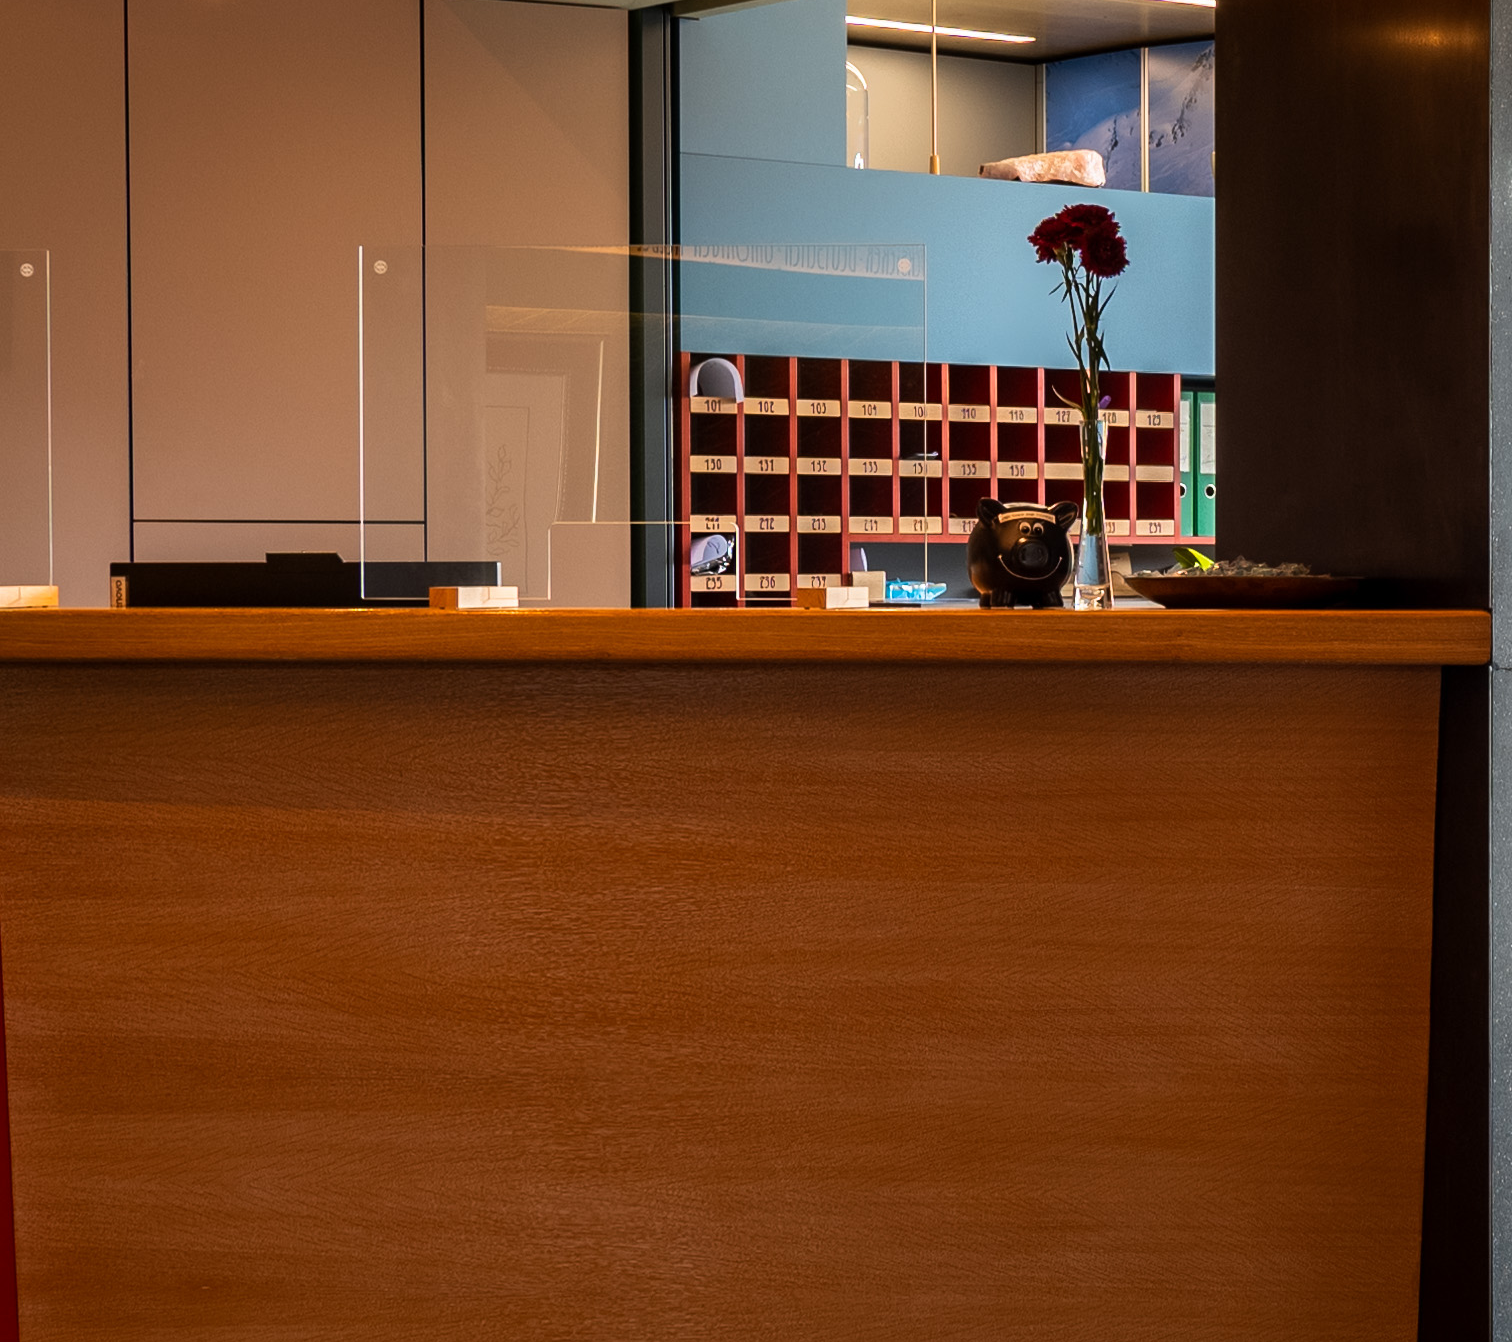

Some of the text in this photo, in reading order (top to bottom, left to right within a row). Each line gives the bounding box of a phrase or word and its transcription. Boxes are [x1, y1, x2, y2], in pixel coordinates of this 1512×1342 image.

[704, 399, 722, 412] 101
[757, 400, 775, 414] 102
[810, 402, 827, 415] 103
[960, 407, 976, 419] 110
[704, 458, 722, 471] 130
[758, 459, 774, 472] 131
[759, 517, 775, 530] 212
[759, 576, 776, 589] 236
